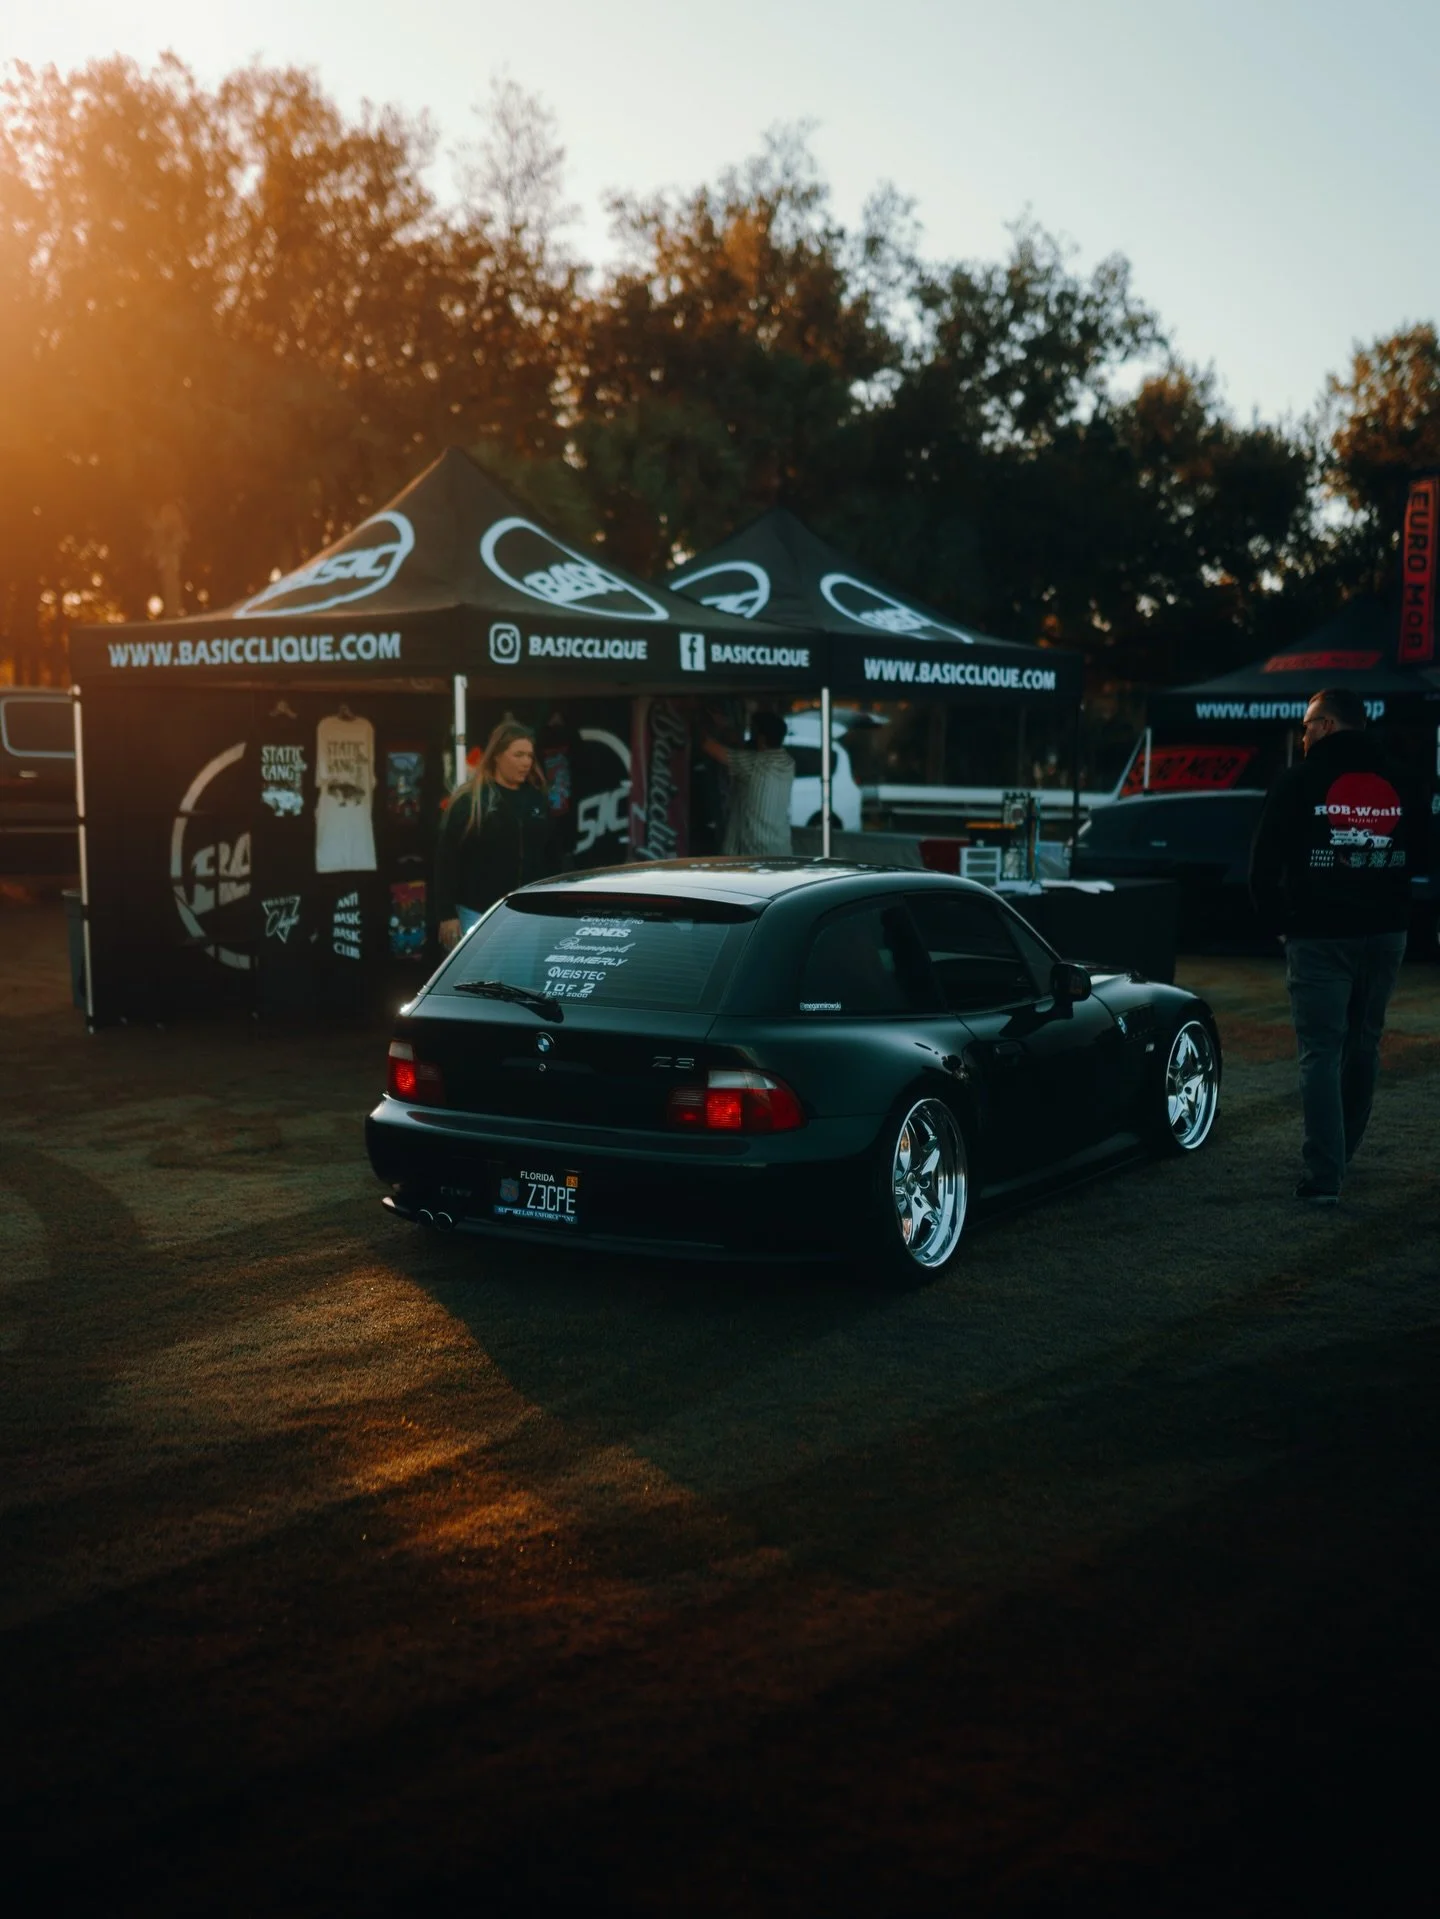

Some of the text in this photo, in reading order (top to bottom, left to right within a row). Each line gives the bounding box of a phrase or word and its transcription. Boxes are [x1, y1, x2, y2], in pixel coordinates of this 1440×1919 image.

[1407, 491, 1429, 572] EURO
[108, 632, 402, 668] WWW.BASICCLIQUE.COM
[528, 634, 648, 660] BASICCLIQUE
[710, 643, 810, 668] BASICCLIQUE
[864, 657, 1056, 690] WWW.BASICCLIQUE.COM
[543, 980, 596, 994] 1 OF 2
[651, 1055, 695, 1069] Z3
[520, 1170, 555, 1182] FLORIDA
[526, 1183, 577, 1214] Z3CPE
[535, 1212, 575, 1222] ENFORCENT
